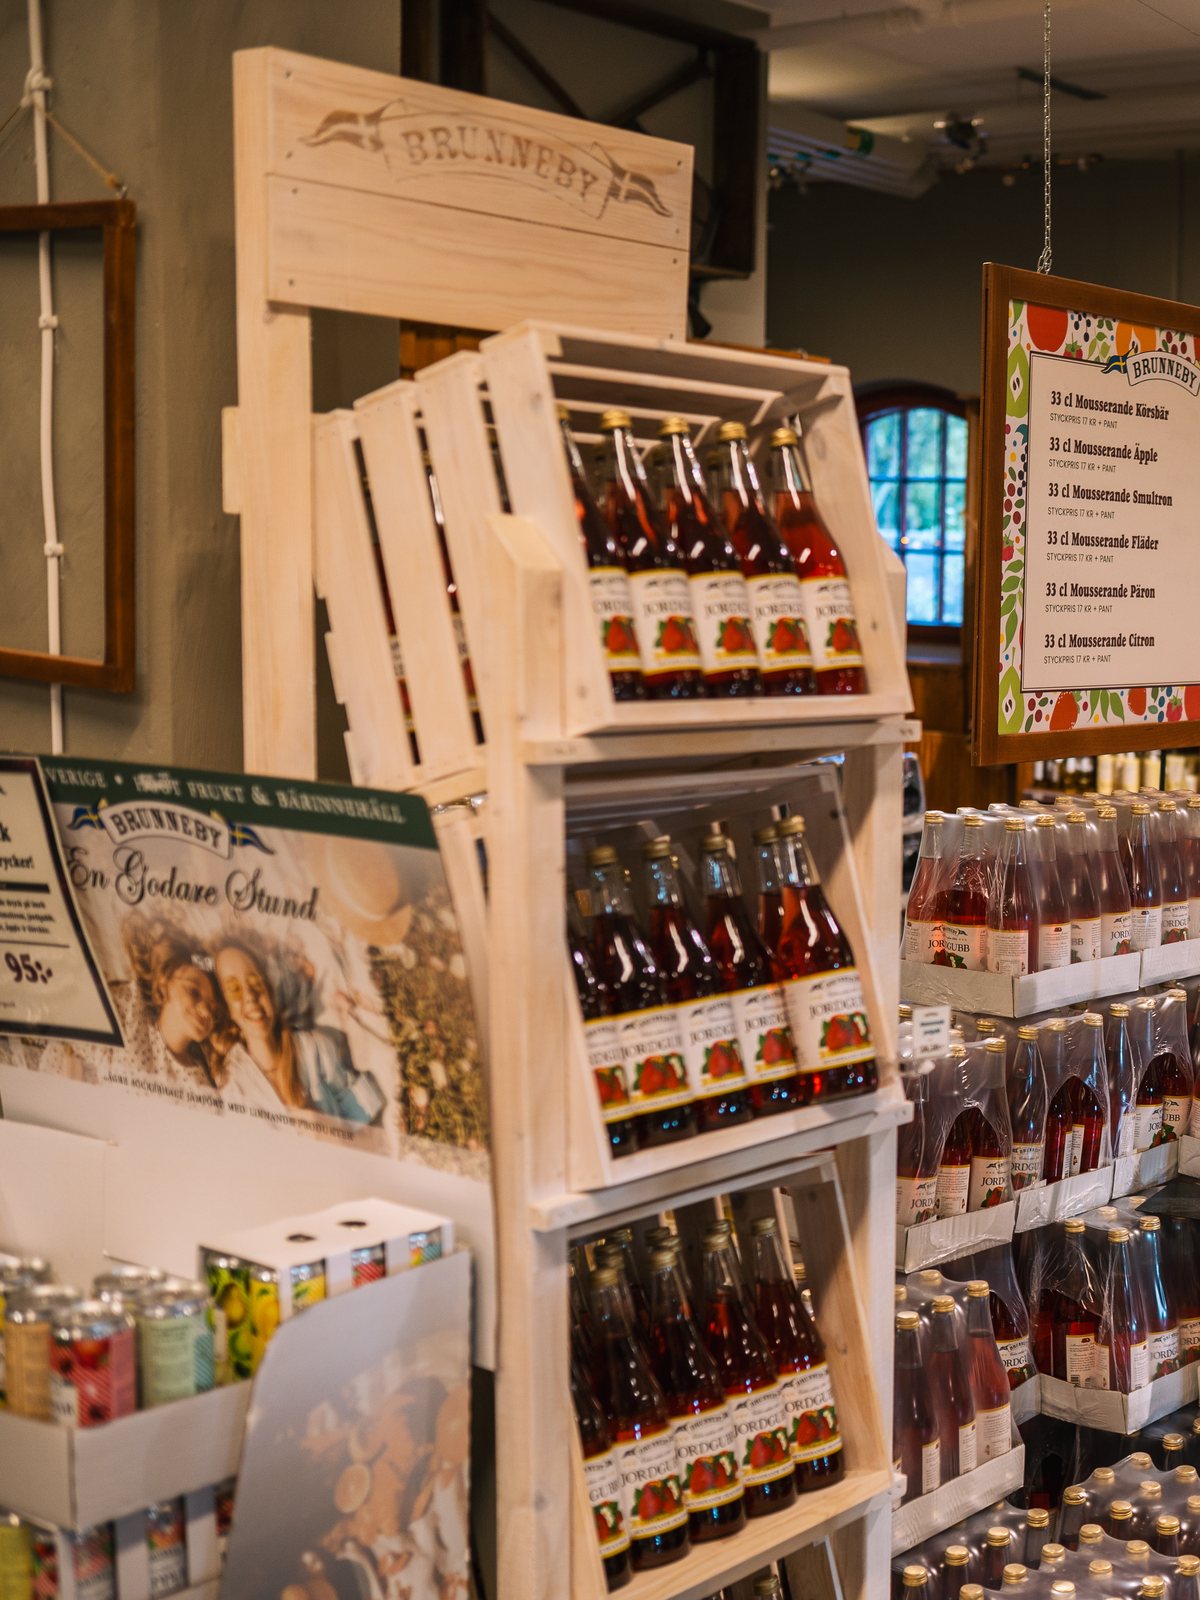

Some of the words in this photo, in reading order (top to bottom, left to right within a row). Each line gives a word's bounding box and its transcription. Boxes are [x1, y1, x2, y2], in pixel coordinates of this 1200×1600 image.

[401, 125, 600, 199] BRUNNEBY
[1132, 357, 1198, 389] BRUNNEBY
[1051, 390, 1061, 405] 33
[1064, 393, 1073, 407] cl
[1075, 394, 1133, 416] Mousserande
[1136, 403, 1169, 421] Körsbär
[1050, 413, 1081, 425] STYCKPRIS
[1089, 418, 1096, 426] KR
[1104, 420, 1118, 429] PANT
[1049, 437, 1060, 451] 33
[1063, 438, 1071, 453] cl
[1073, 440, 1131, 460] Mousserande
[1134, 443, 1158, 465] Äpple
[1048, 459, 1079, 470] STYCKPRIS
[1087, 463, 1095, 471] KR
[1102, 465, 1116, 473] PANT
[1048, 483, 1059, 497] 33
[1062, 484, 1070, 498] cl
[1072, 485, 1130, 503] Mousserande
[1133, 490, 1173, 507] Smultron
[1047, 507, 1078, 517] STYCKPRIS
[1087, 509, 1094, 518] KR
[1101, 511, 1115, 519] PANT
[1047, 531, 1058, 545] 33
[1060, 531, 1069, 546] cl
[1071, 532, 1130, 549] Mousserande
[1131, 535, 1159, 550] Fläder
[1046, 552, 1077, 561] STYCKPRIS
[1085, 554, 1093, 562] KR
[1100, 555, 1114, 563] PANT
[1046, 582, 1056, 597] 33
[1059, 582, 1067, 597] cl
[1070, 583, 1128, 598] Mousserande
[1130, 584, 1155, 598] Päron
[1045, 604, 1076, 613] STYCKPRIS
[1084, 605, 1091, 613] KR
[1099, 605, 1112, 613] PANT
[1044, 634, 1055, 648] 33
[1058, 633, 1066, 648] cl
[1069, 633, 1126, 648] Mousserande
[1129, 633, 1155, 647] Citron
[1043, 655, 1075, 664] STYCKPRIS
[1083, 655, 1090, 663] KR
[1097, 655, 1111, 663] PANT
[43, 766, 106, 789] VERIGE
[186, 780, 245, 804] FRUKT
[250, 784, 271, 806] &
[110, 804, 222, 847] BRUNNEBY
[67, 846, 110, 892] En
[112, 845, 218, 907] Godare
[225, 867, 320, 922] Stund
